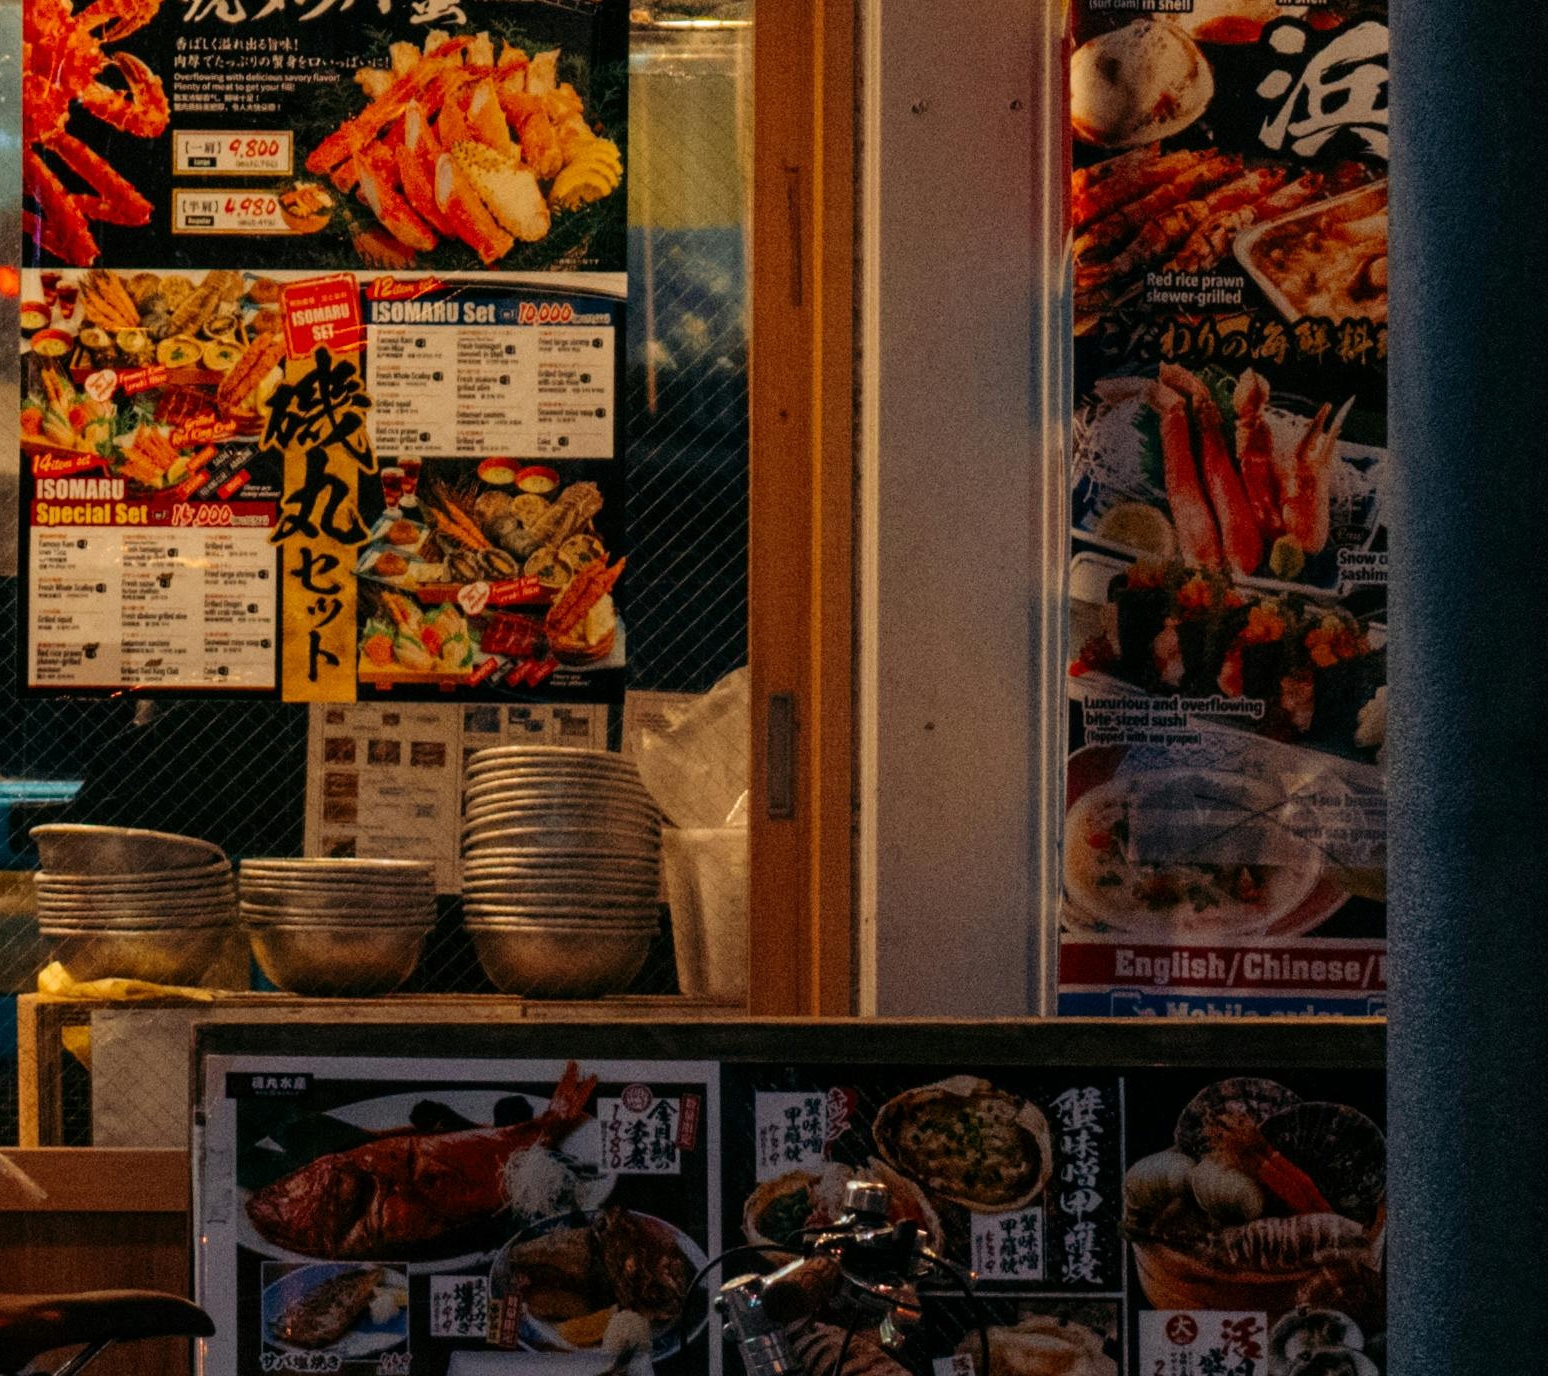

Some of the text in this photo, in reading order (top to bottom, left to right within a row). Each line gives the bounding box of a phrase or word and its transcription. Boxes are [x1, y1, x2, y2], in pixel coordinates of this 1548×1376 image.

[1147, 272, 1244, 291] Red rice prawn
[1146, 289, 1241, 305] skewer-grilled
[291, 303, 352, 327] ISOMARU
[371, 301, 496, 323] ISOMARU Set
[36, 478, 125, 500] ISOMARU
[36, 502, 149, 526] Special Set
[1084, 699, 1263, 716] Luxurious and overflowing
